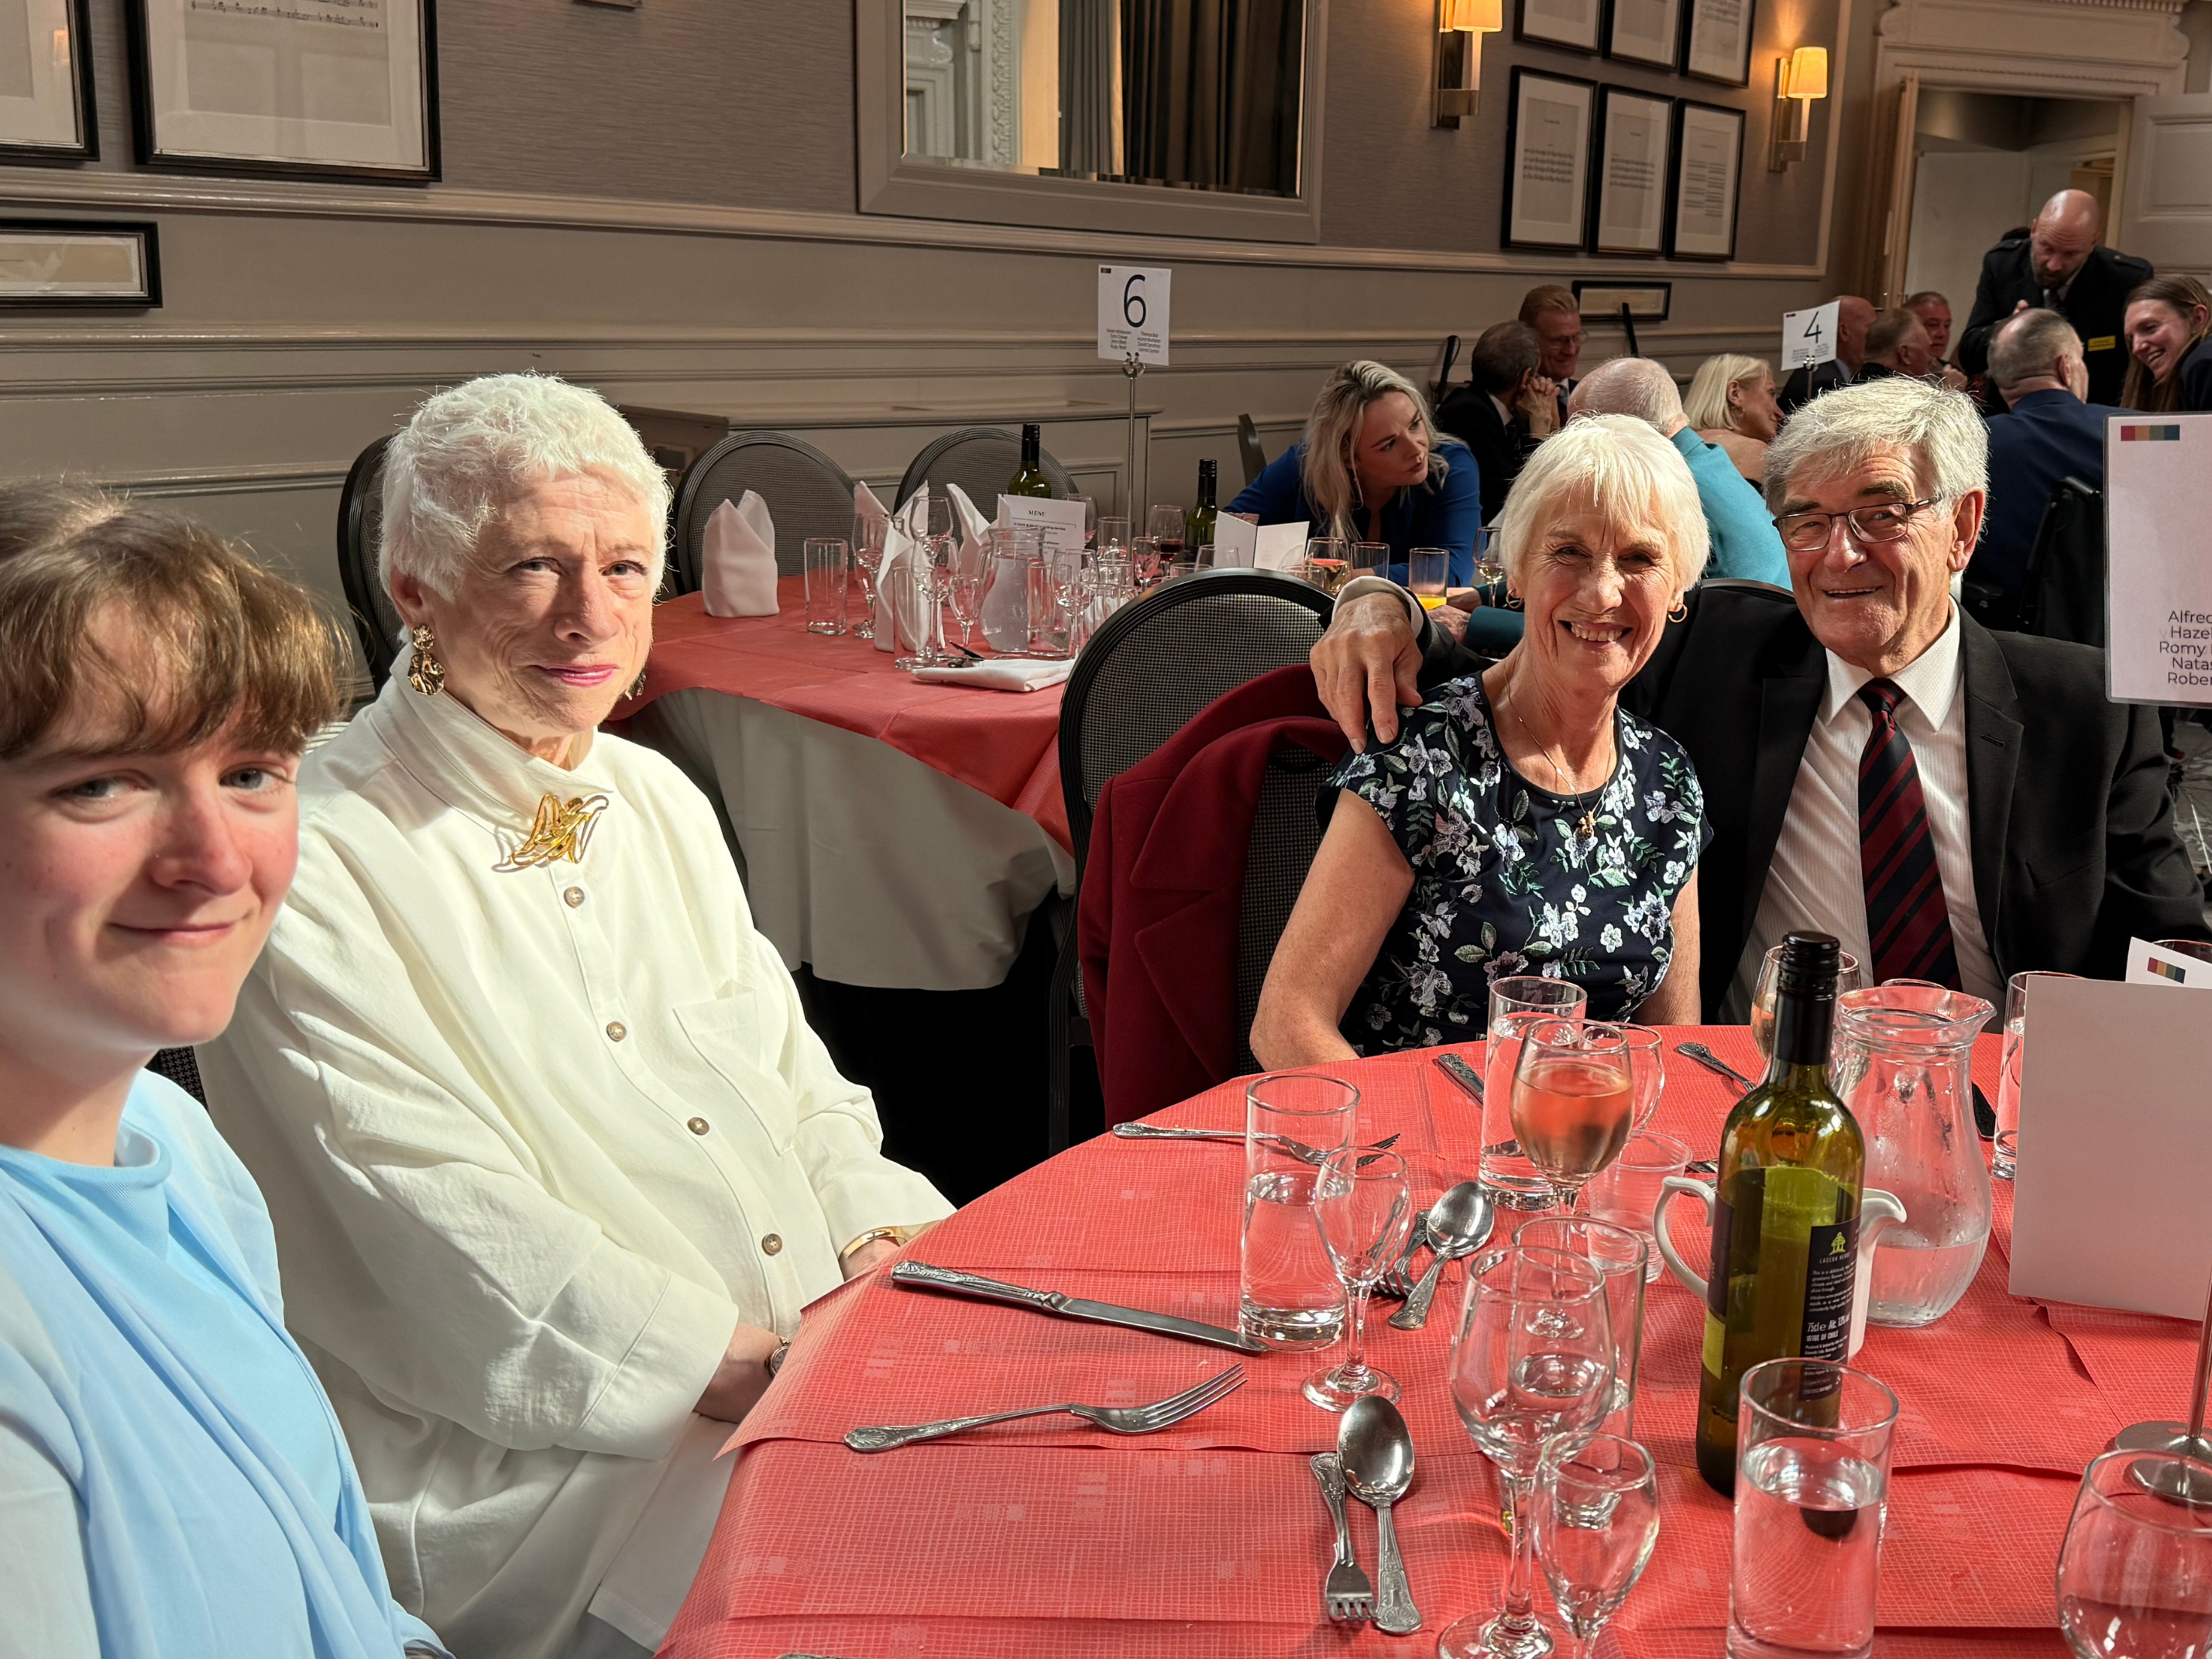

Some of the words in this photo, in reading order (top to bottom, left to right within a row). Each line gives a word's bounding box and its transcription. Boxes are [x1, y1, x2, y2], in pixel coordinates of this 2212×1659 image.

[1124, 274, 1146, 328] 6
[1804, 311, 1822, 344] 4
[2159, 641, 2206, 658] Romy
[2172, 657, 2212, 671] Nata
